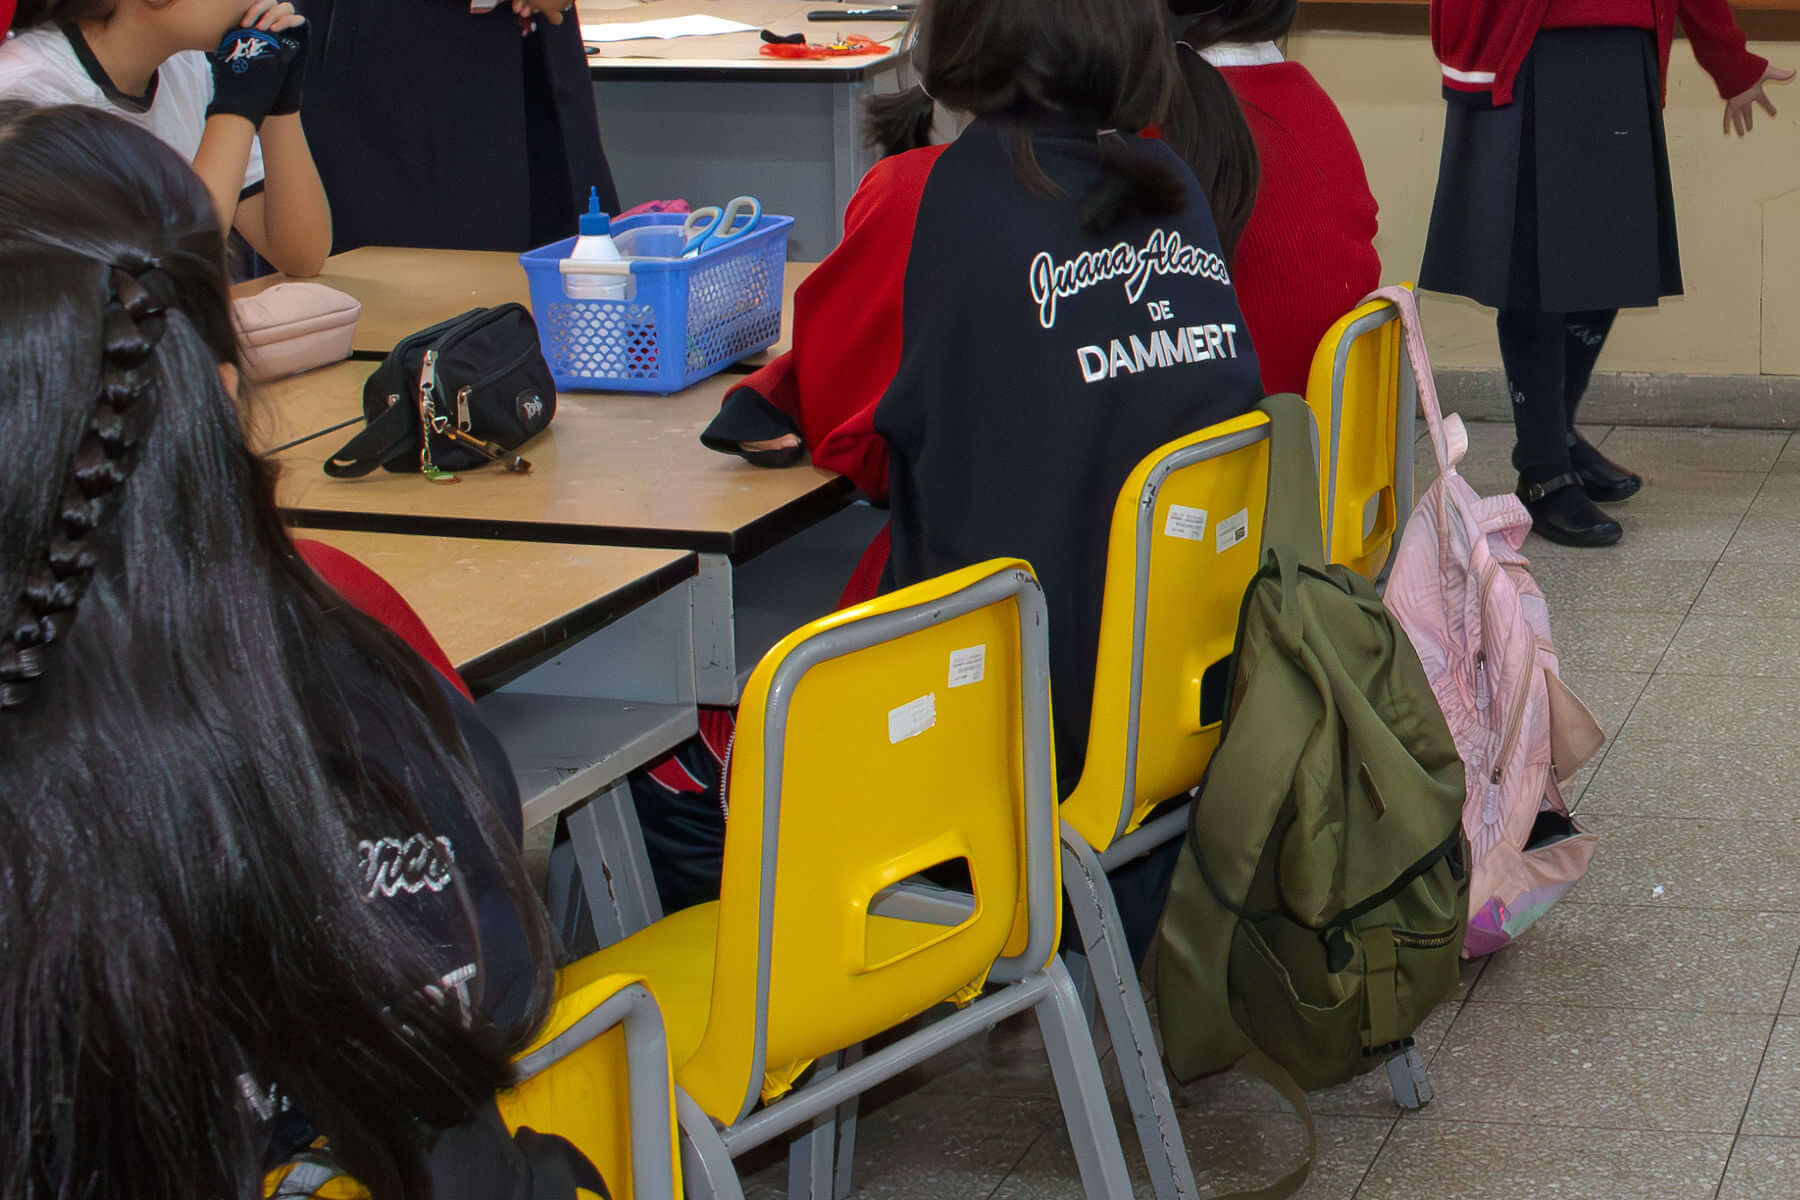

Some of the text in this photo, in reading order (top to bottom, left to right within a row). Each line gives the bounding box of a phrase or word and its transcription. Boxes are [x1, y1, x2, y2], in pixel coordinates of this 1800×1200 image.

[1030, 228, 1231, 328] Juana Alarco
[1146, 300, 1174, 321] DE
[1076, 323, 1238, 384] DAMMERT
